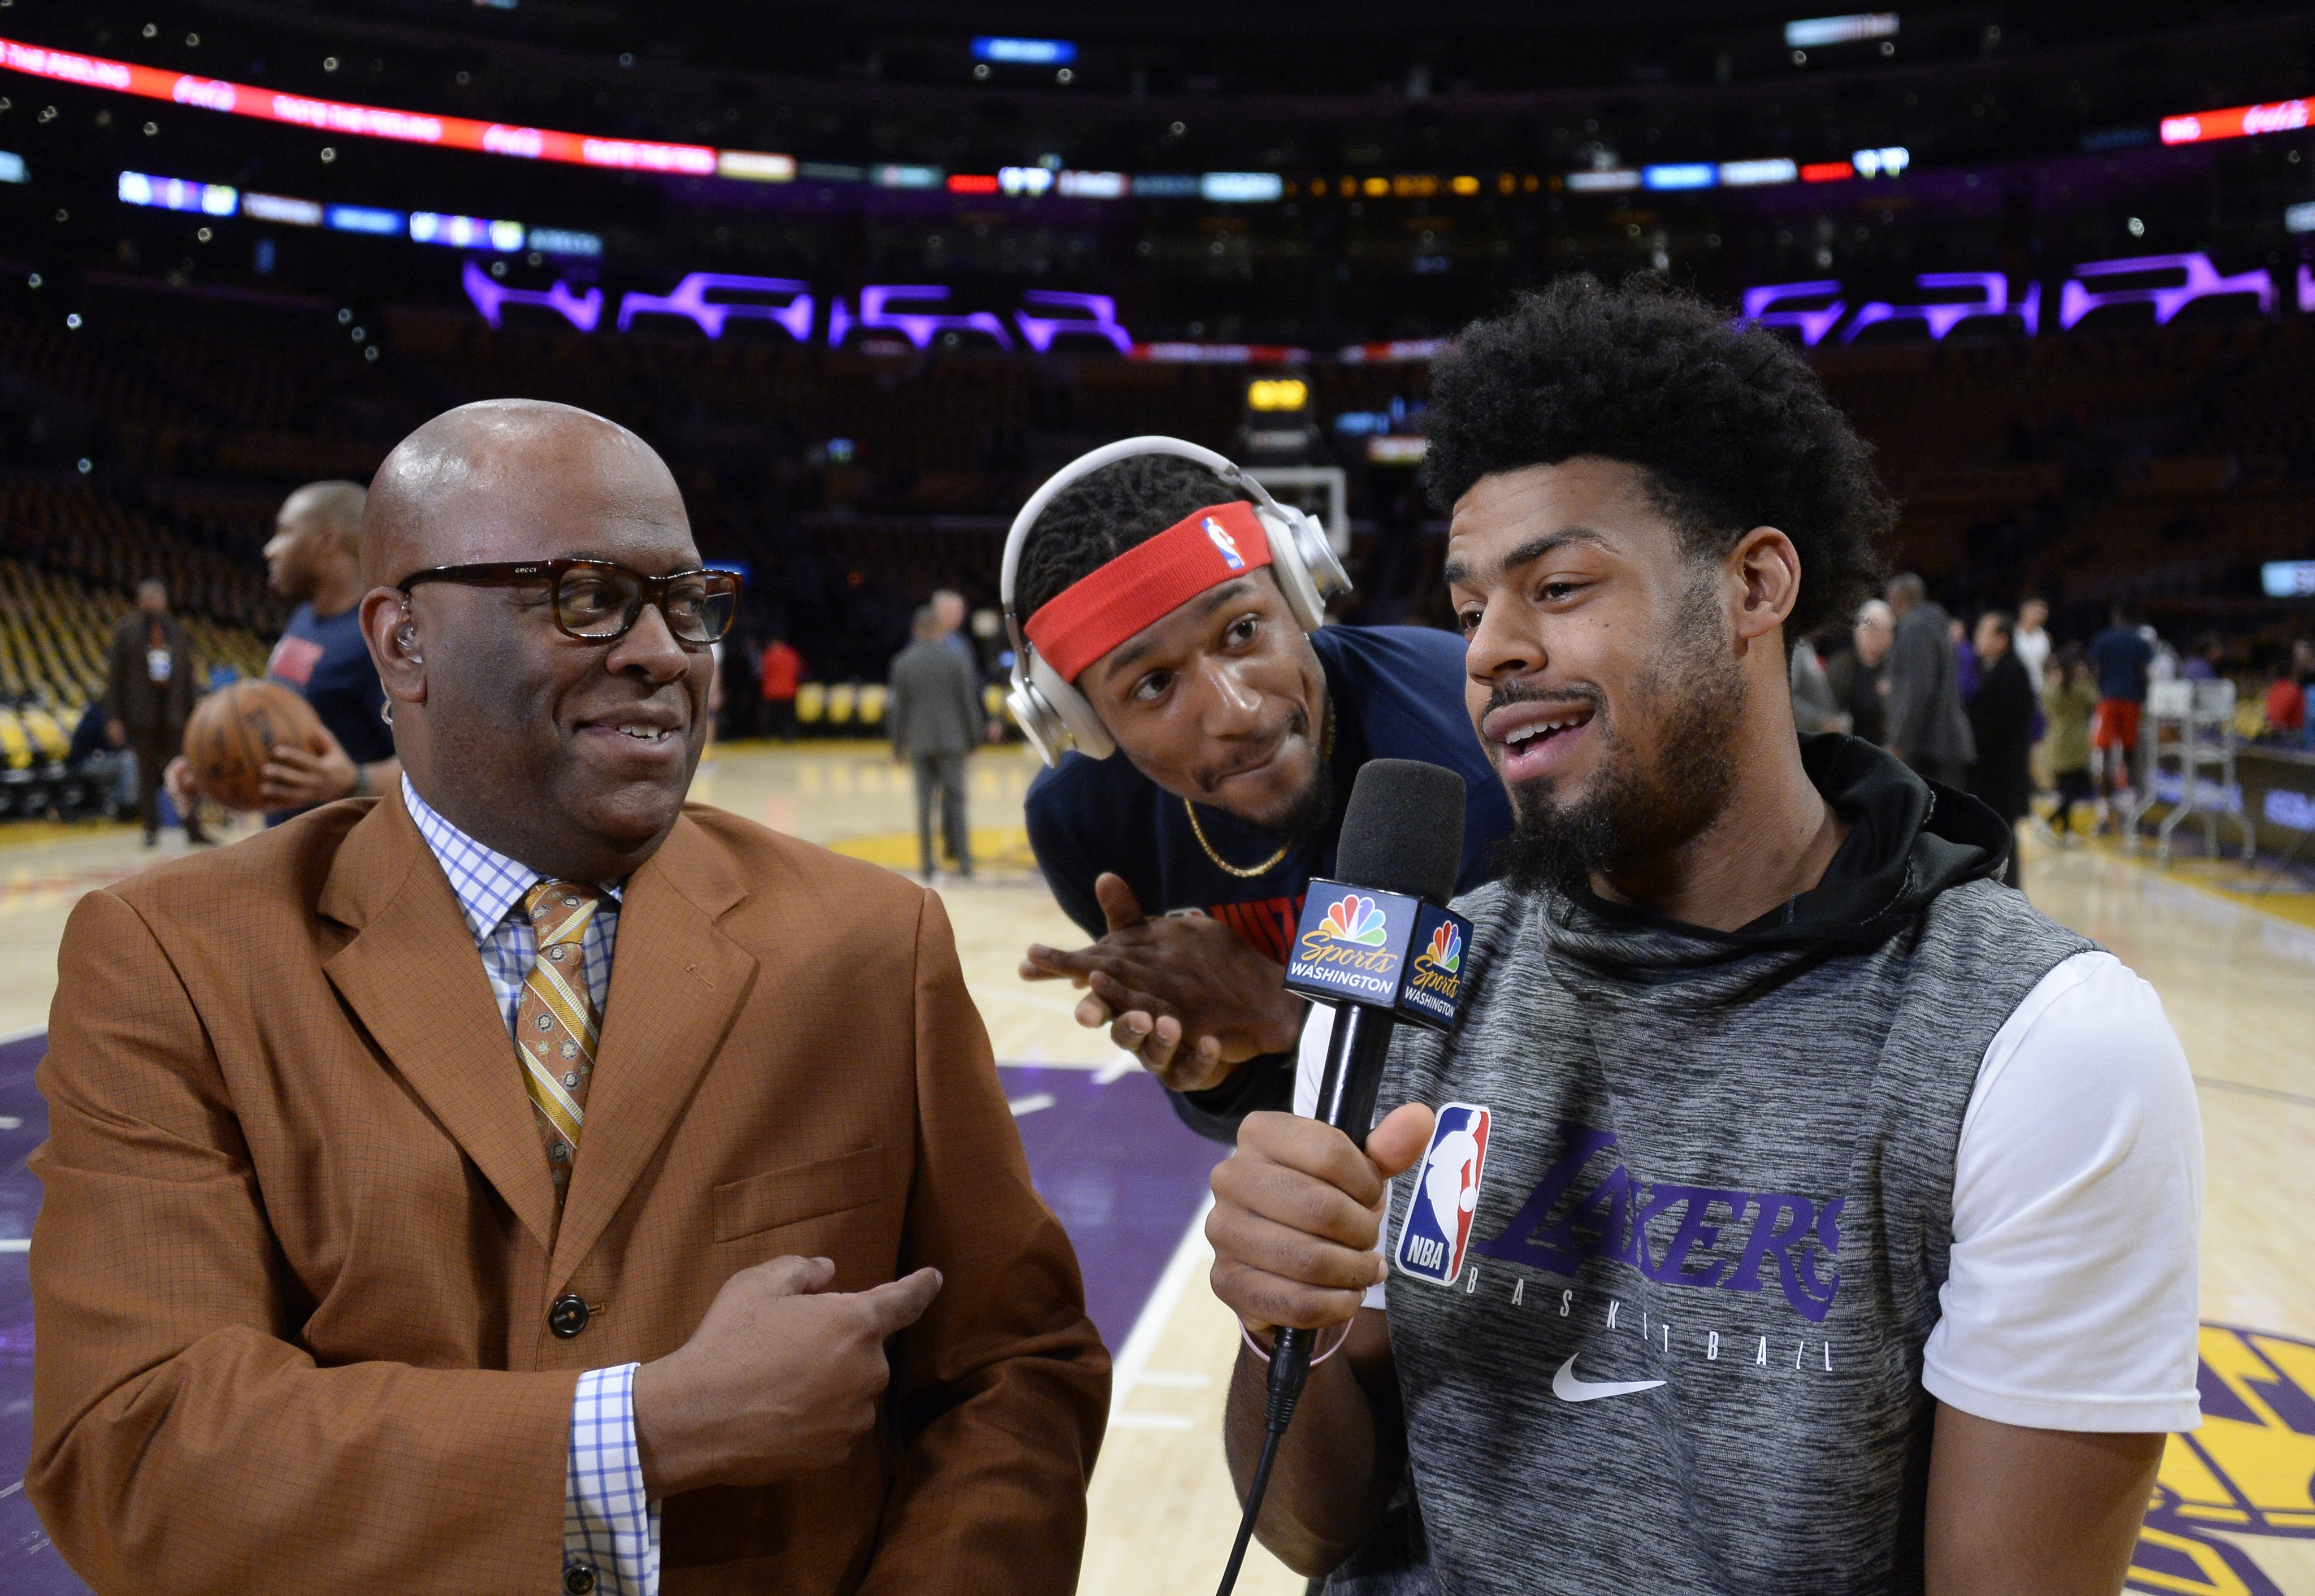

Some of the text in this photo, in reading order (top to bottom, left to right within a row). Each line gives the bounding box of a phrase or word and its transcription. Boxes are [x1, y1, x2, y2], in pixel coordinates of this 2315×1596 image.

[1301, 929, 1398, 973] Sports
[1290, 961, 1394, 995] WASHINGTON
[1412, 953, 1460, 998] Sports
[1404, 986, 1456, 1018] WASHINGTON
[1473, 1121, 1846, 1322] LAKERS
[1406, 1234, 1445, 1270] NBA
